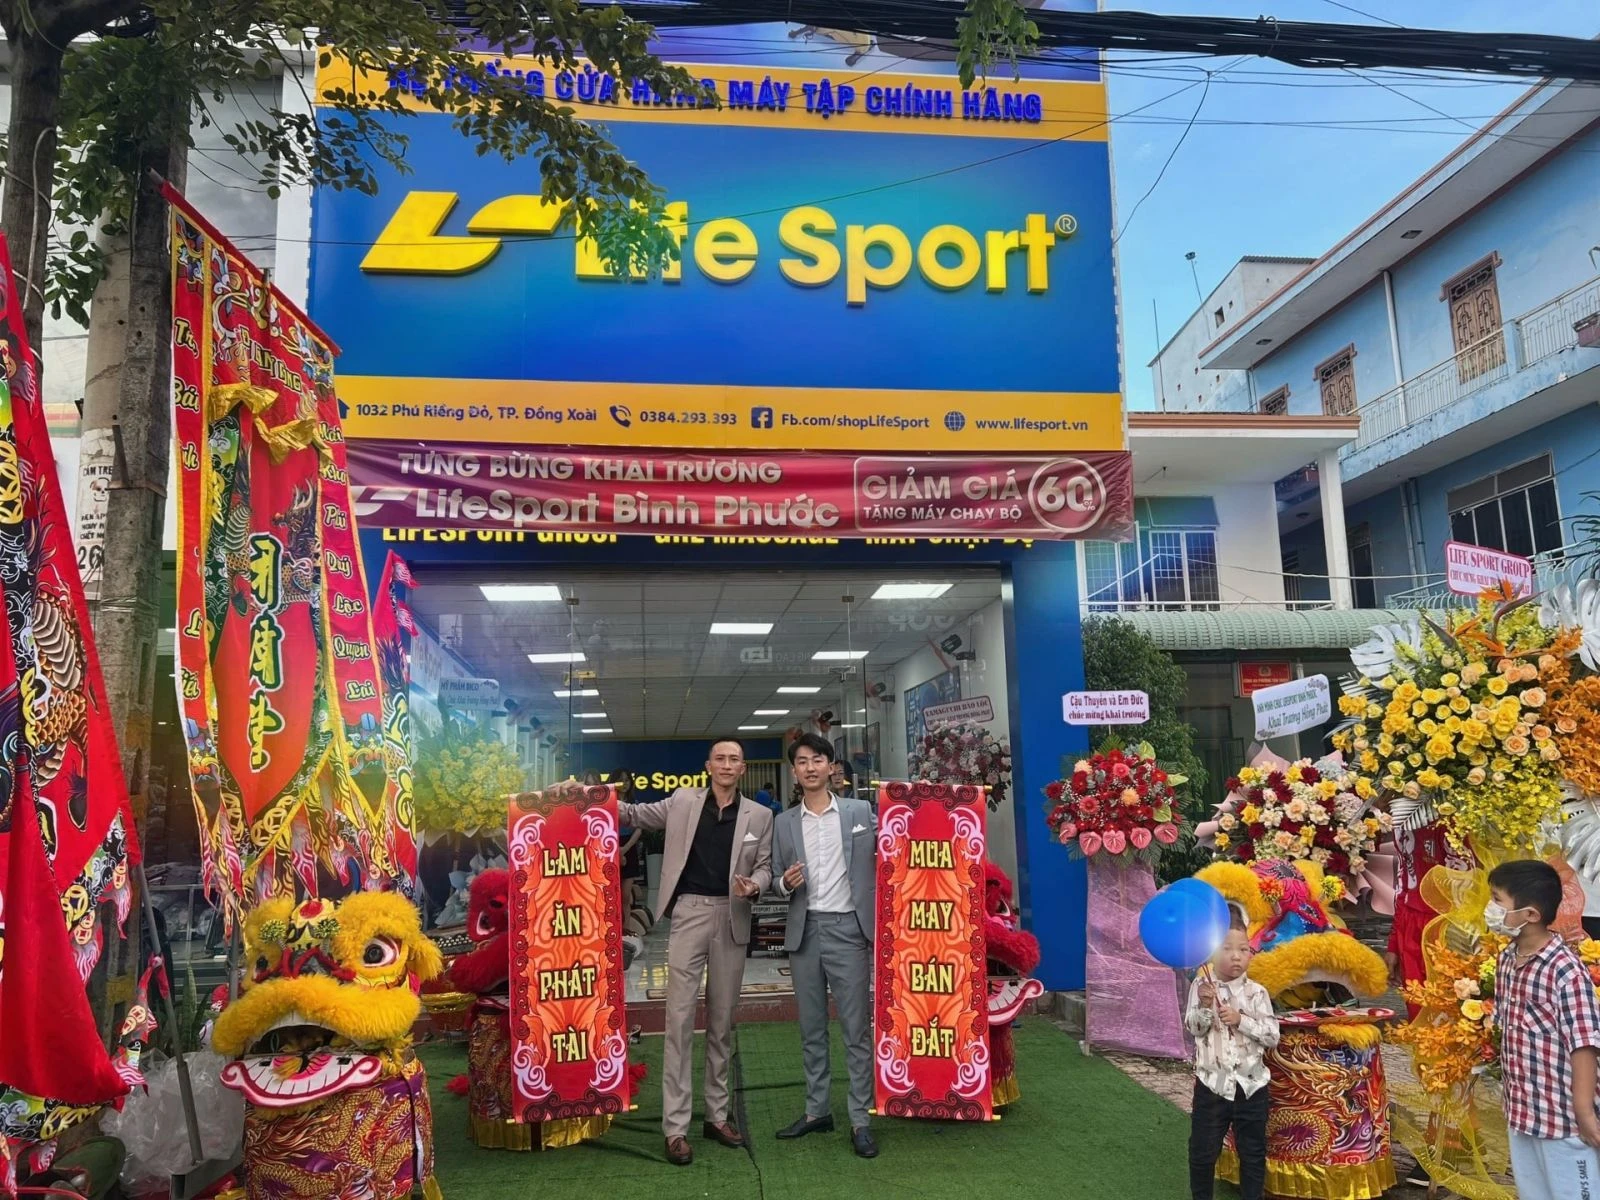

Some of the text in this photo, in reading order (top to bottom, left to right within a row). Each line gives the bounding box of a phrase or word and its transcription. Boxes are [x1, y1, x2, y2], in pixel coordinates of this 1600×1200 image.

[729, 74, 790, 111] MÁY
[803, 78, 855, 118] TẬP
[865, 82, 952, 118] CHÍNH
[962, 87, 1042, 123] HÃNG
[356, 404, 388, 417] 1032
[392, 404, 420, 417] Phú
[497, 406, 519, 420] TP.
[523, 404, 563, 424] Đồng
[566, 407, 598, 421] Xoài
[639, 409, 737, 427] 0384.293.393
[781, 412, 930, 431] Fb.com/shopLifeSport
[975, 417, 1088, 432] www.lifesport.vn
[490, 451, 574, 480] BỪNG
[584, 459, 653, 482] KHAI
[663, 458, 782, 483] TRƯƠNG
[862, 466, 1023, 501] GIẢM GIÁ
[416, 488, 840, 528] LifeSport Bình Phước
[911, 504, 947, 521] MÁY
[999, 505, 1022, 523] BỘ
[1449, 547, 1530, 579] LIFE SPORT GROUP
[1105, 709, 1121, 719] khai
[1118, 695, 1129, 705] Em
[652, 771, 708, 792] Sport
[910, 839, 954, 869] MUA
[910, 901, 954, 930] MAY
[539, 842, 596, 1063] LÀM ĂN PHÁT TÀI
[911, 958, 954, 994] BÁN
